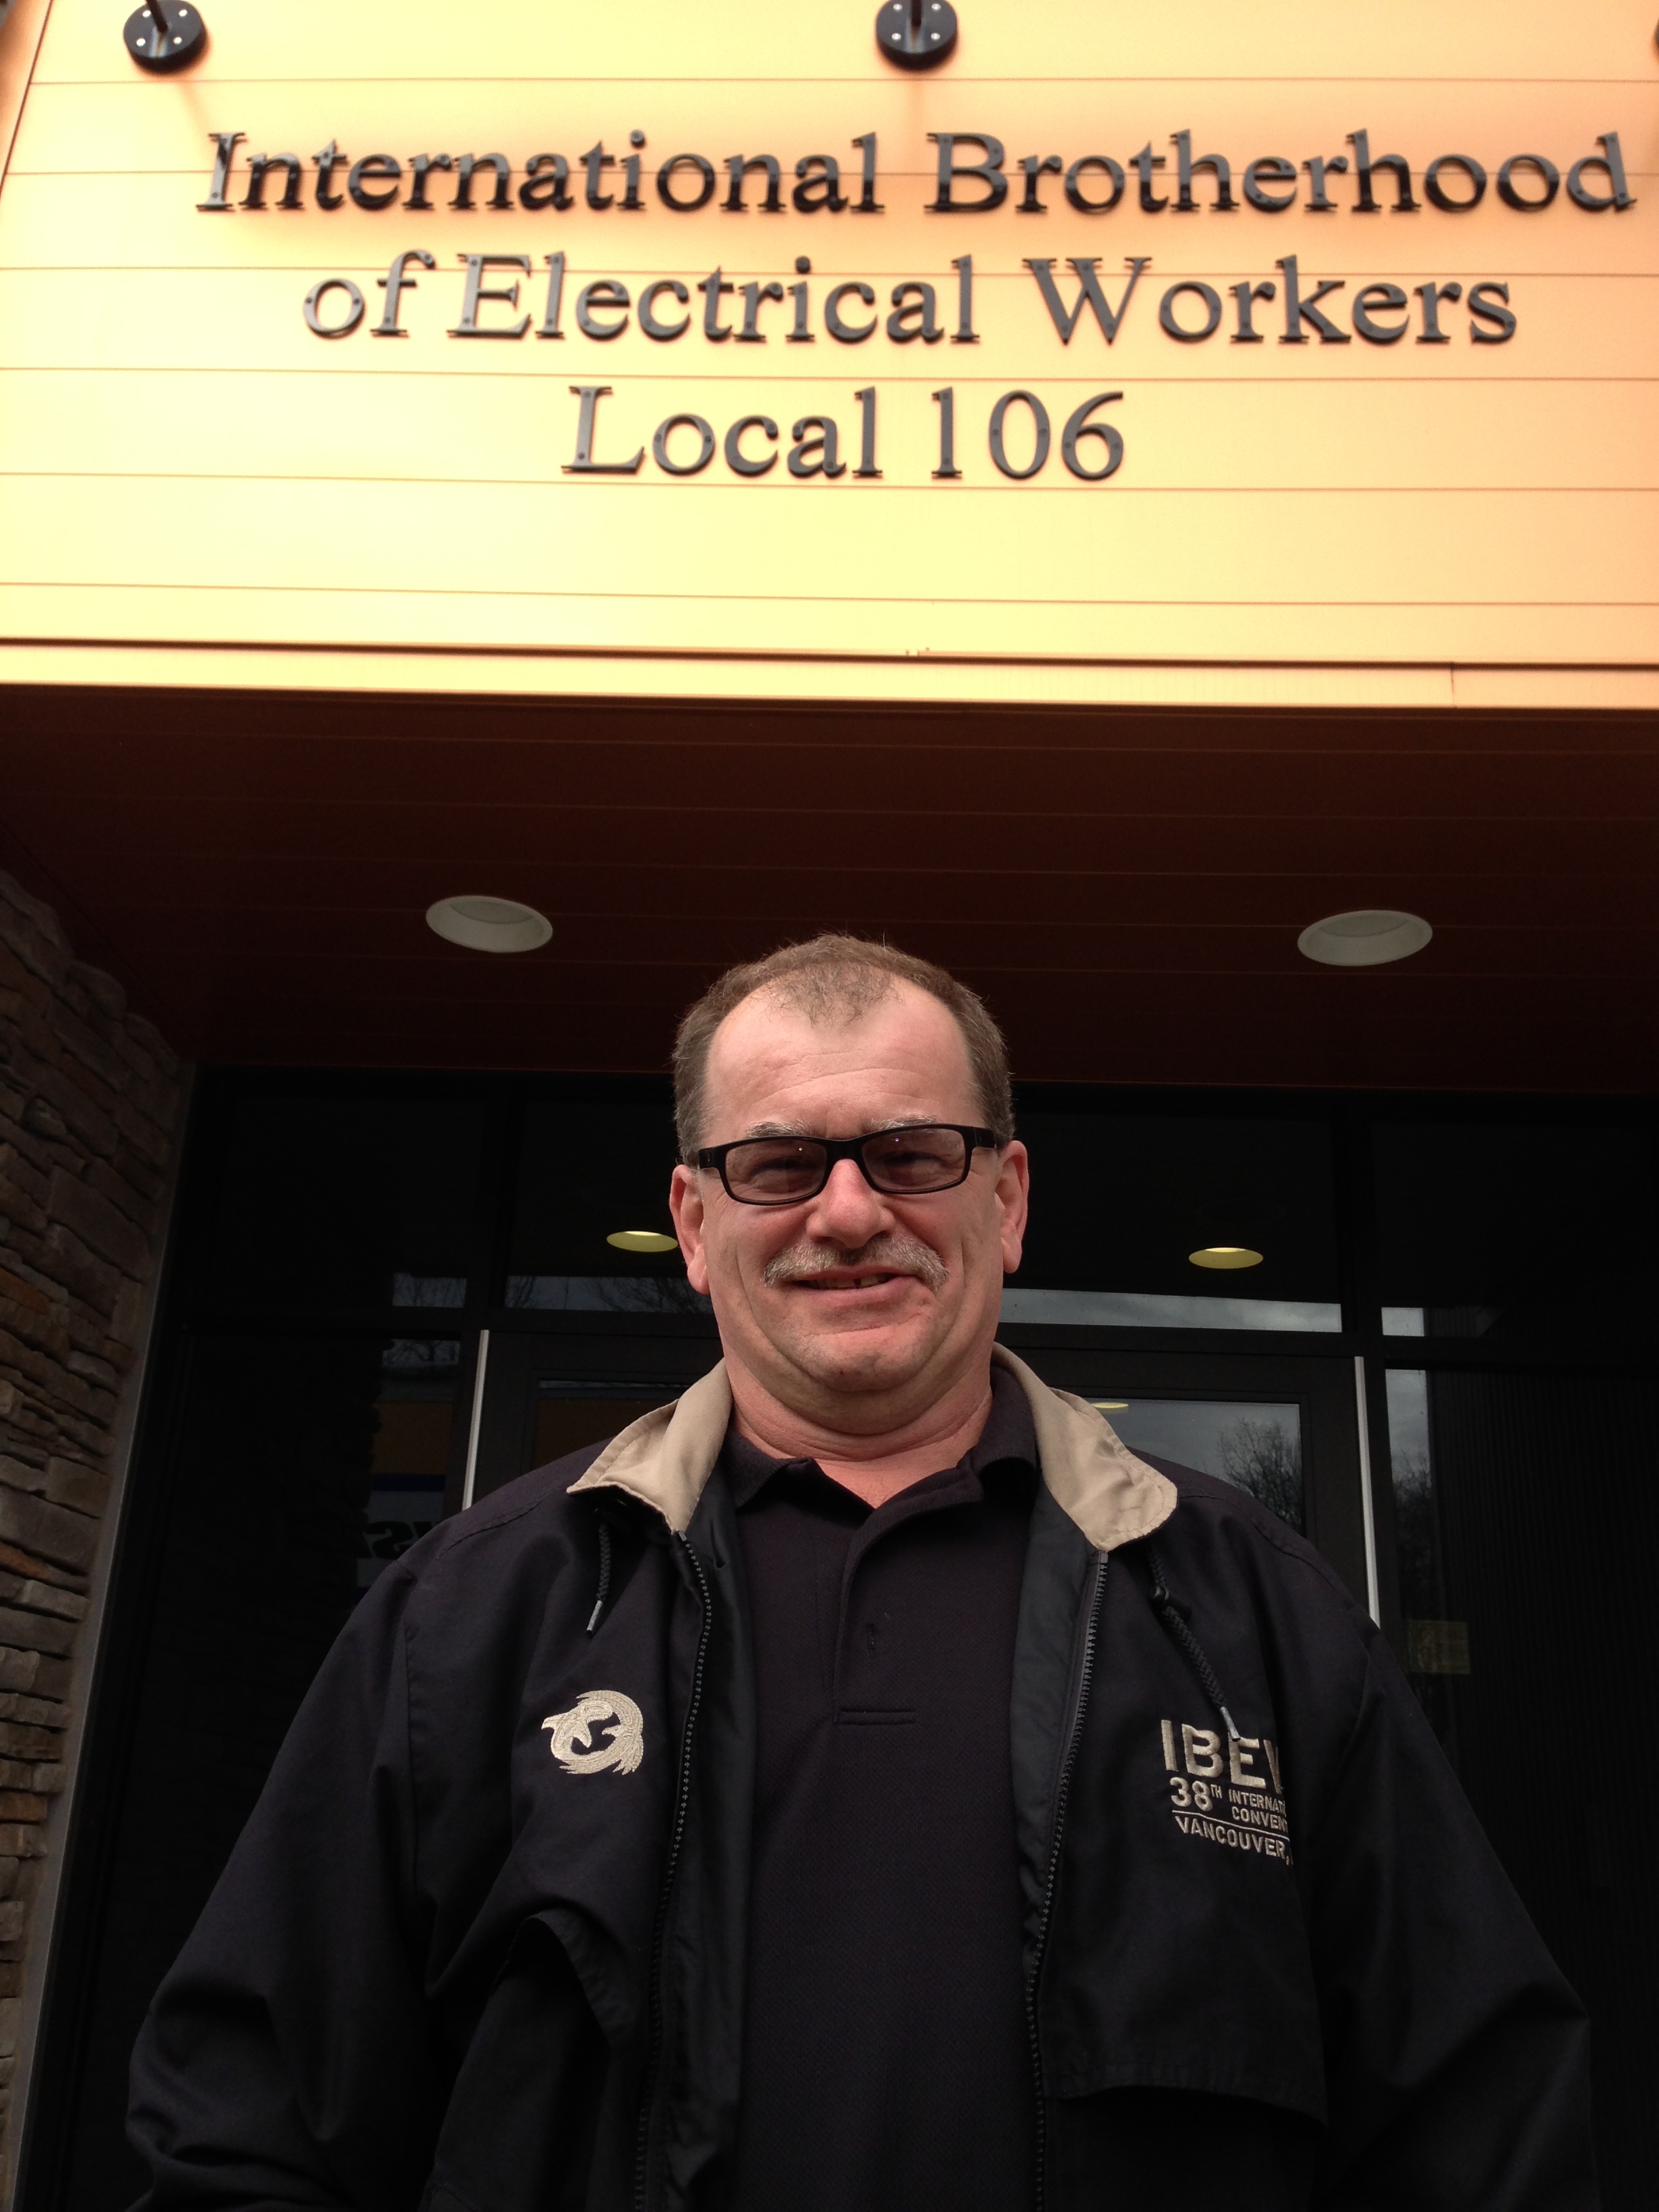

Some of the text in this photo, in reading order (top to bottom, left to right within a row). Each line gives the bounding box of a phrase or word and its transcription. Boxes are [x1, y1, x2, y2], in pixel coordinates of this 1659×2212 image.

[197, 129, 1637, 213] International Brotherhood
[303, 249, 1517, 344] of Electrical Workers
[561, 386, 1125, 480] Local 106
[1170, 1777, 1223, 1811] 38TH
[1175, 1816, 1290, 1865] VANCOUVER,
